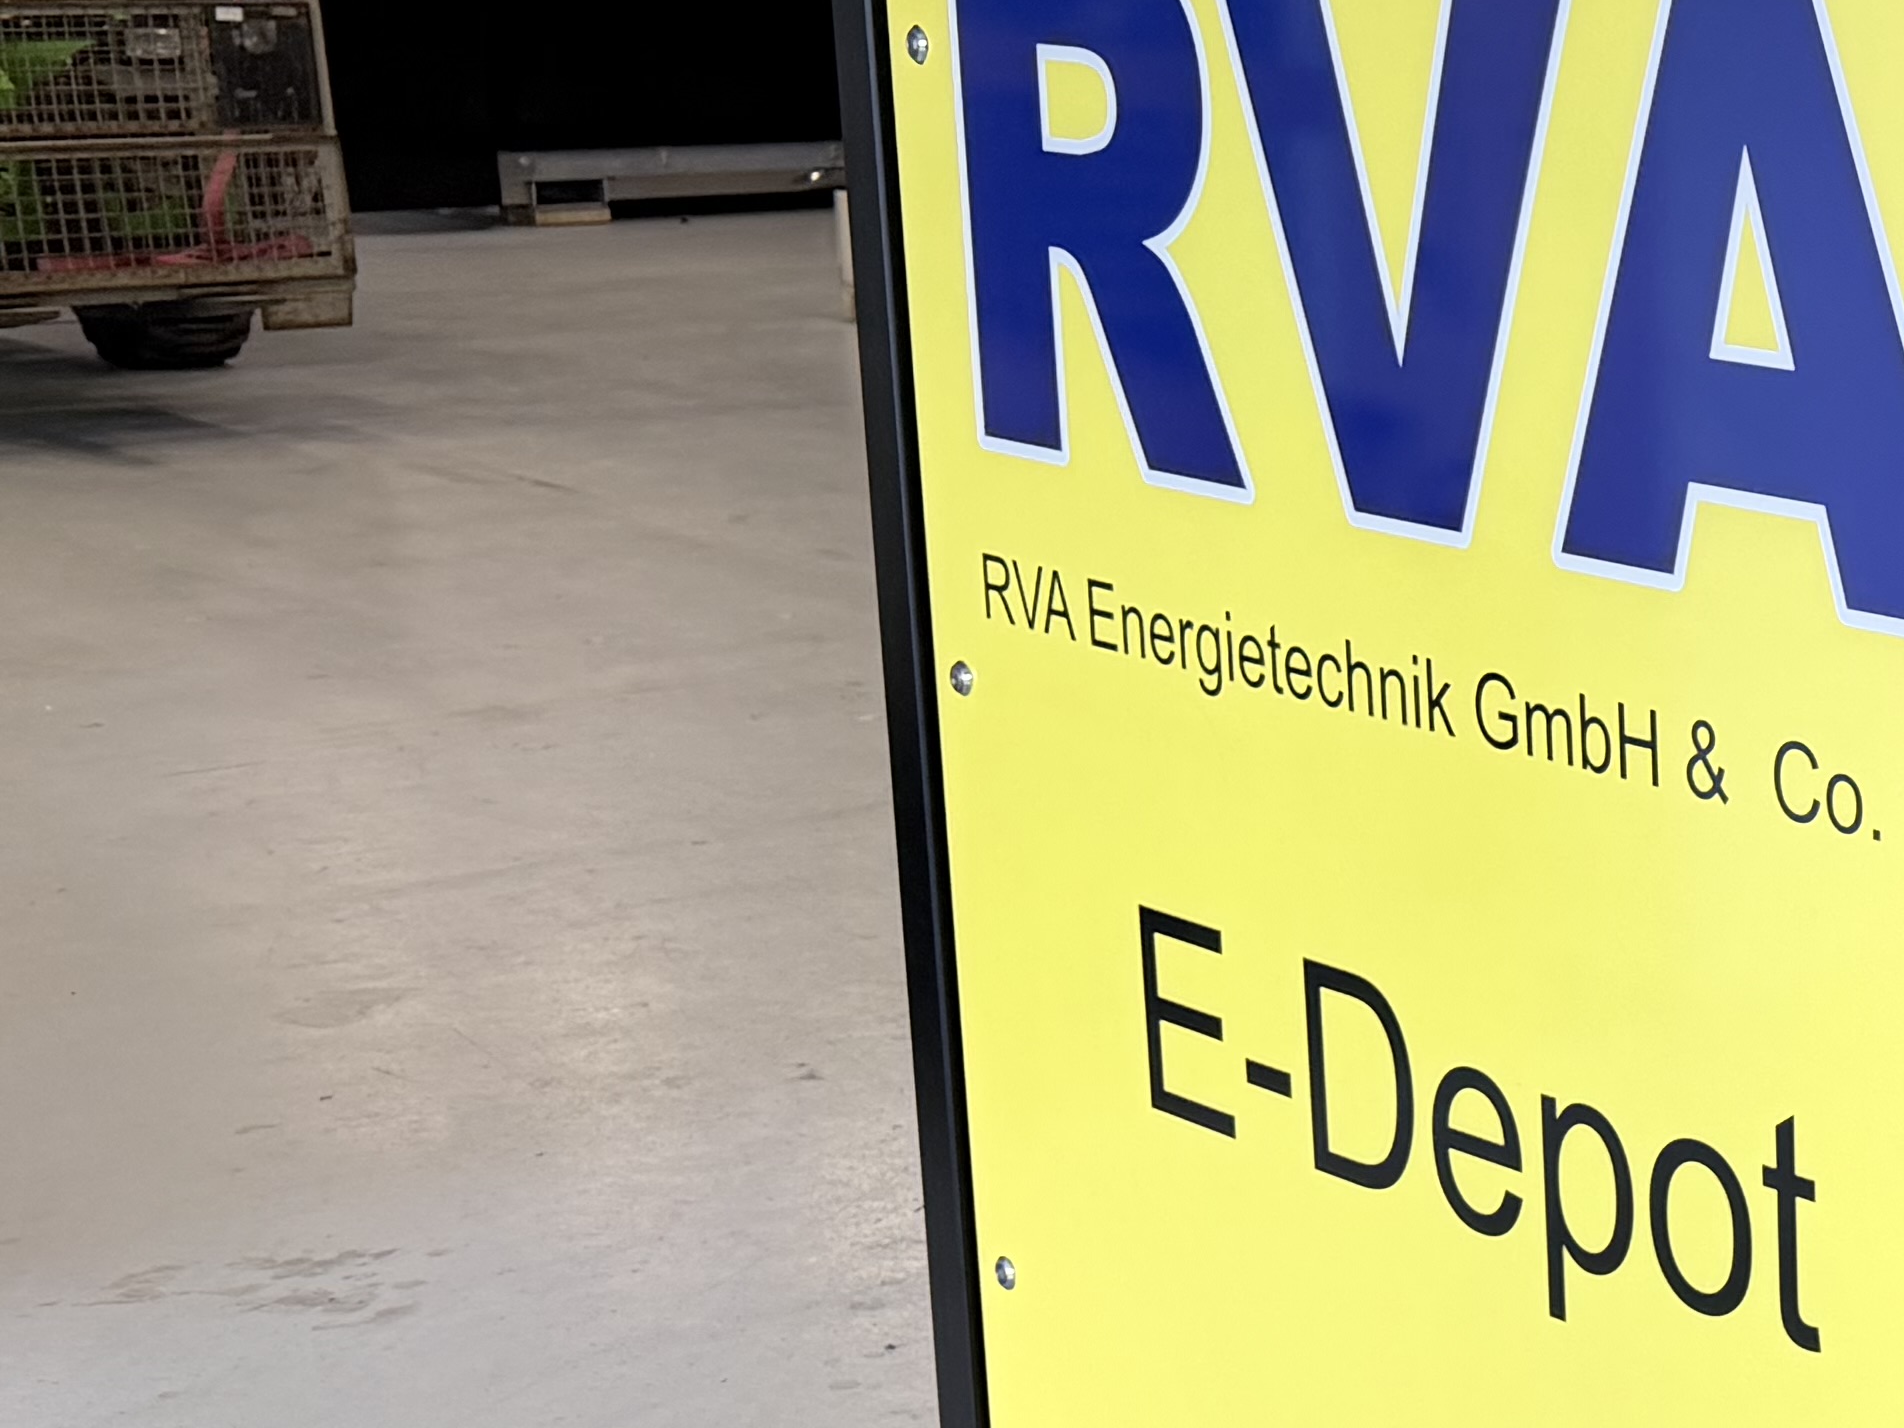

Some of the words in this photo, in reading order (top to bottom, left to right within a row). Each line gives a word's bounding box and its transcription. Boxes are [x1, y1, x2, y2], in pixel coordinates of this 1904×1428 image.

[982, 553, 1076, 641] RVA
[1087, 578, 1456, 738] Energietechnik
[1475, 672, 1660, 788] GmbH
[1686, 719, 1729, 804] &
[1773, 740, 1882, 843] Co.
[1138, 904, 1822, 1354] E-Depot
